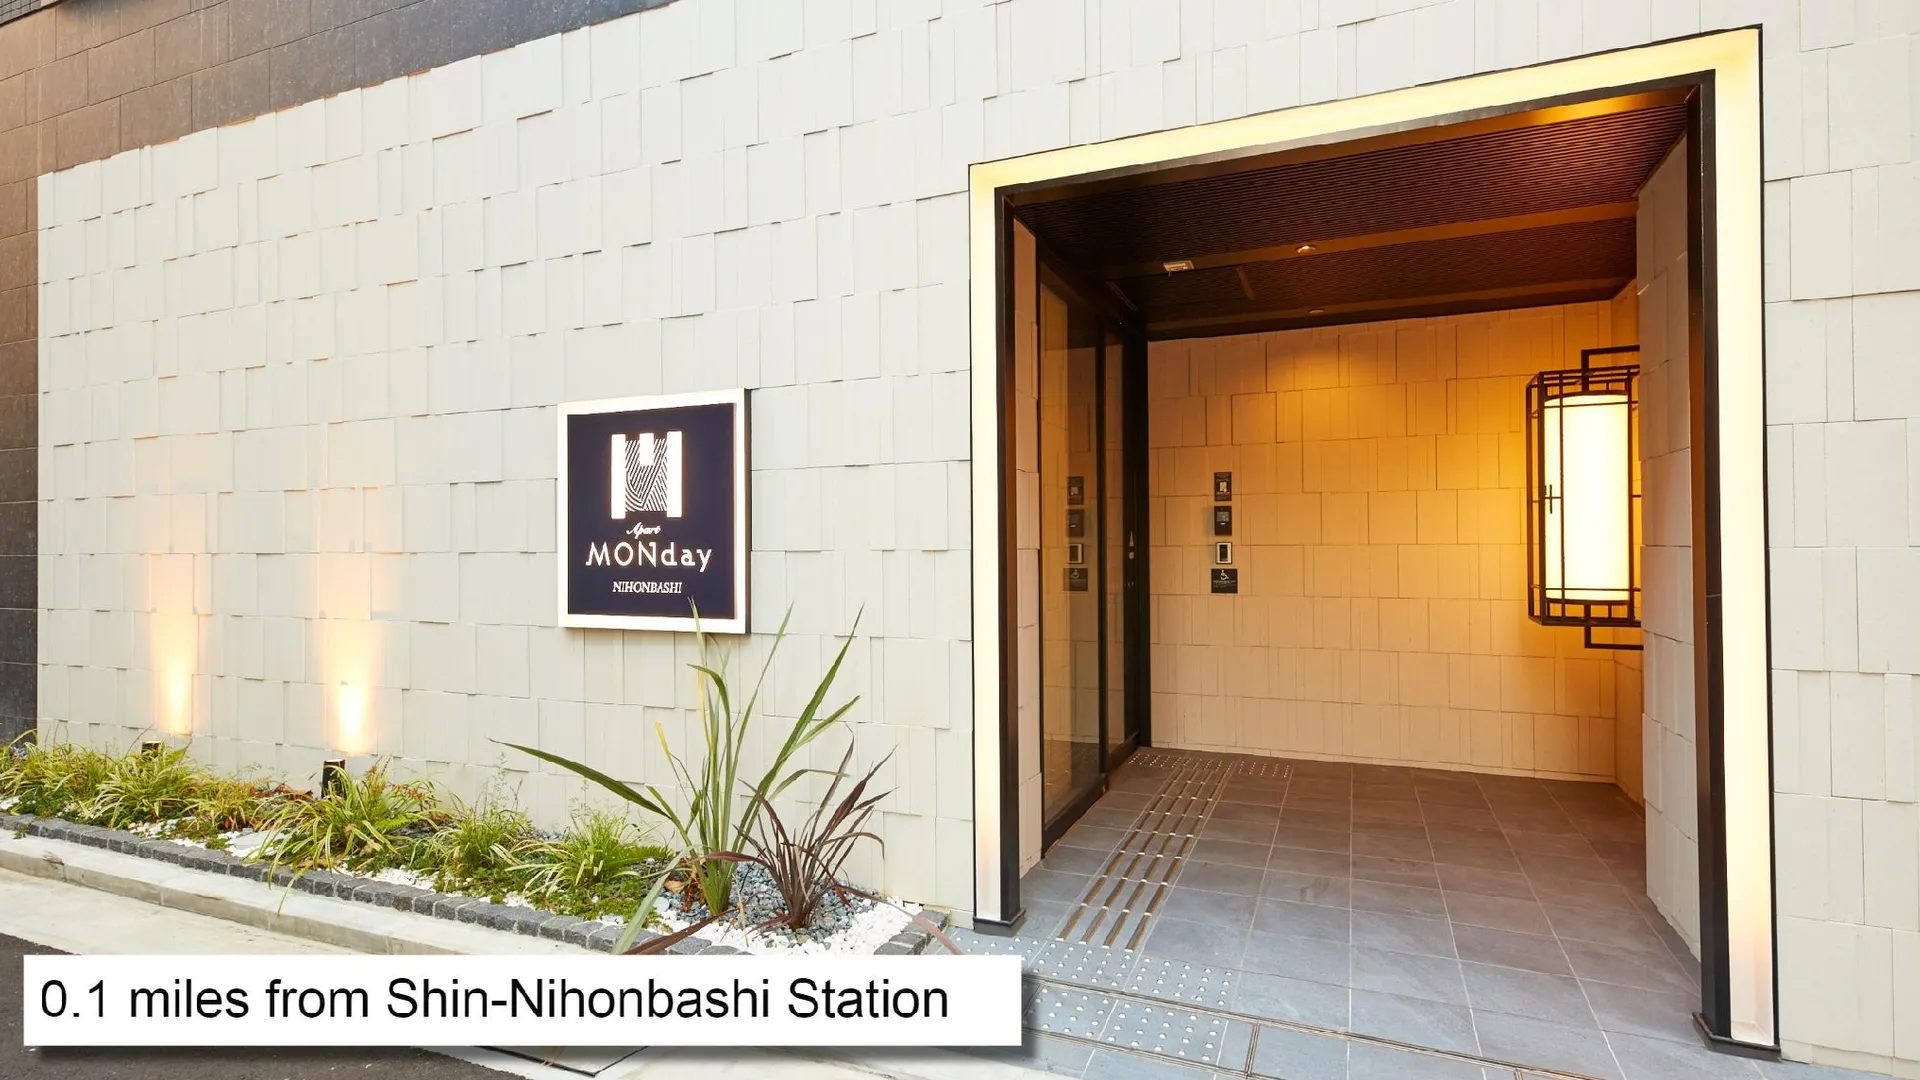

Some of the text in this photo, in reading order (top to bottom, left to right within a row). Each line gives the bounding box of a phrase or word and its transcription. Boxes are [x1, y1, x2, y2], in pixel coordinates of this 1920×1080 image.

[626, 521, 661, 540] Apart
[585, 541, 713, 573] MONday
[612, 581, 683, 594] NIHONBASHI
